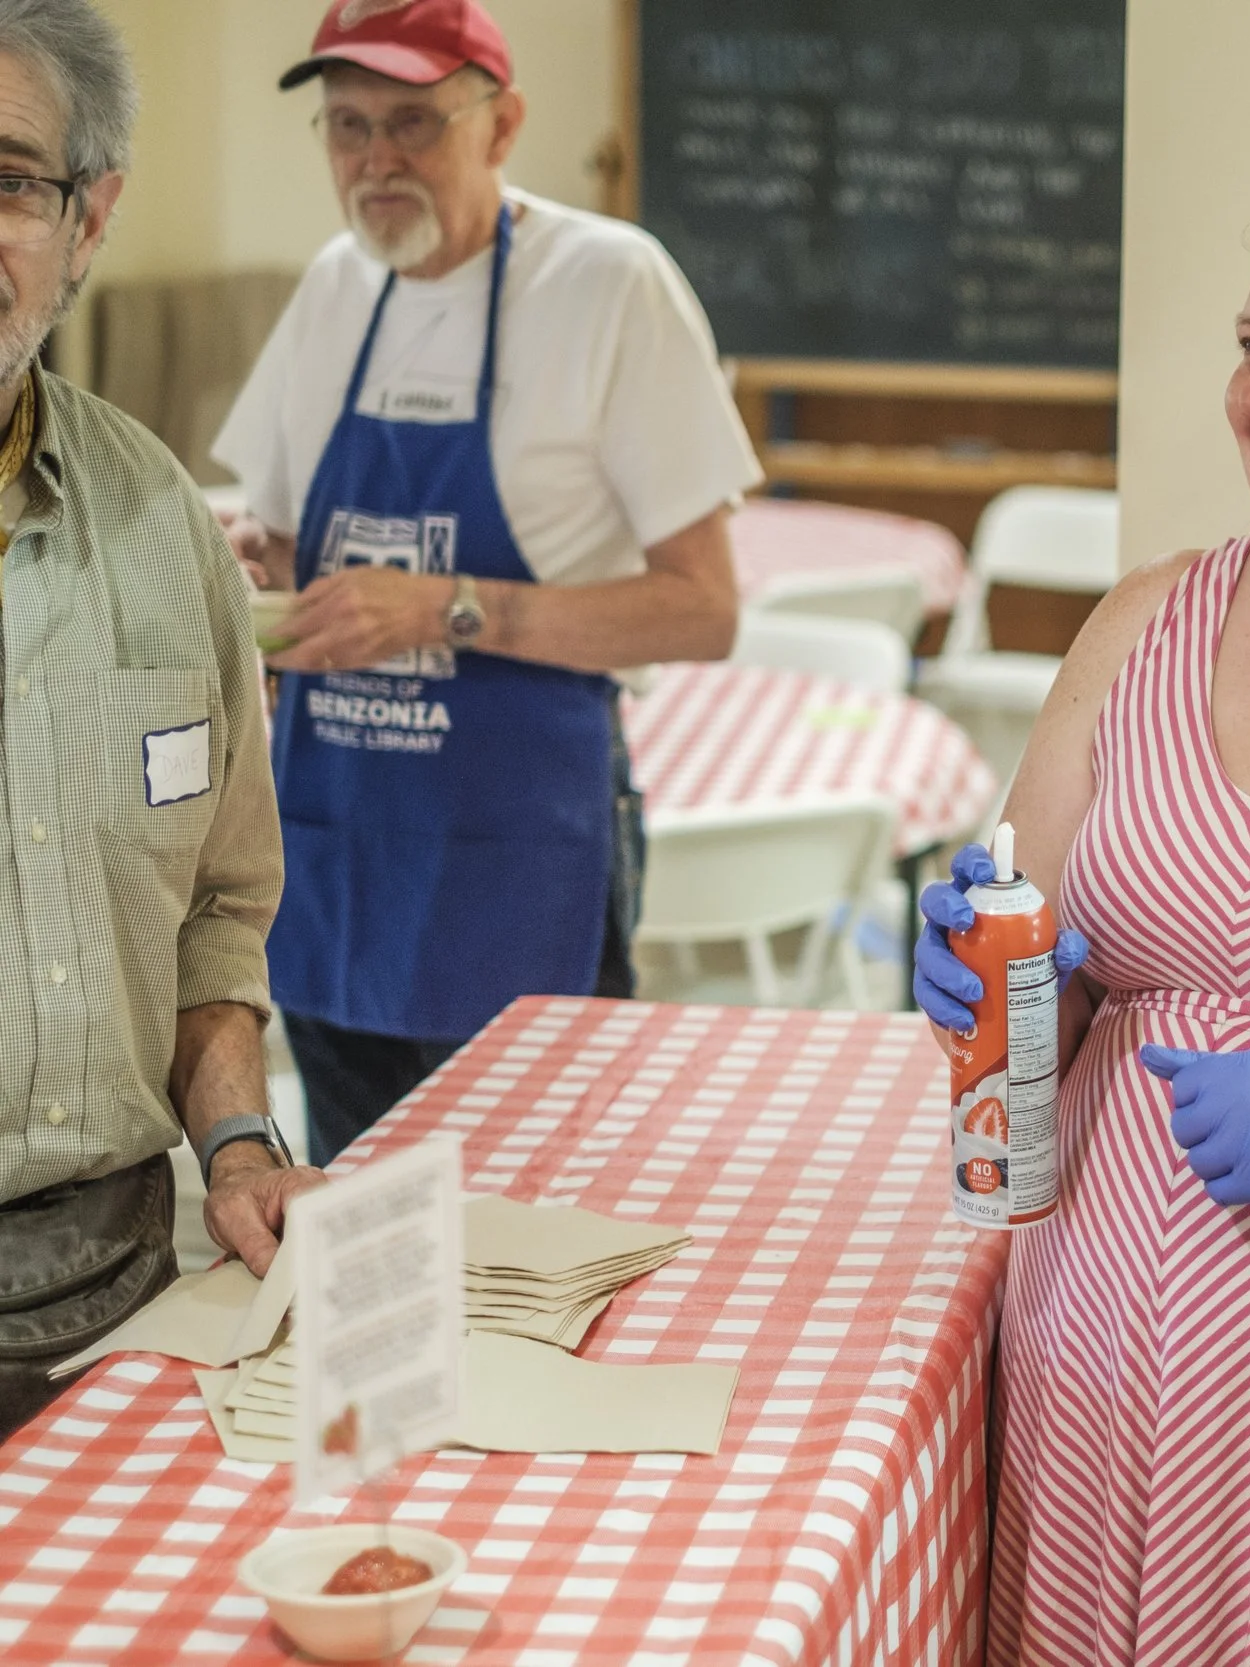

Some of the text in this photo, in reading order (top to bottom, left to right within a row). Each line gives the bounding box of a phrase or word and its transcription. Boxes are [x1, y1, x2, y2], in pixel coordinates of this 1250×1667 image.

[396, 678, 423, 698] OF
[306, 689, 451, 732] BENZONIA
[365, 729, 443, 753] LIBRARY
[156, 748, 199, 783] DAVE
[1008, 958, 1046, 971] Nutrition
[1009, 995, 1042, 1006] Calories
[973, 1161, 992, 1176] NO
[970, 1174, 995, 1184] ARTIFICIAL
[972, 1181, 993, 1190] FLAVORS
[966, 1201, 974, 1211] OZ
[975, 1204, 990, 1215] (425
[991, 1207, 999, 1217] g)
